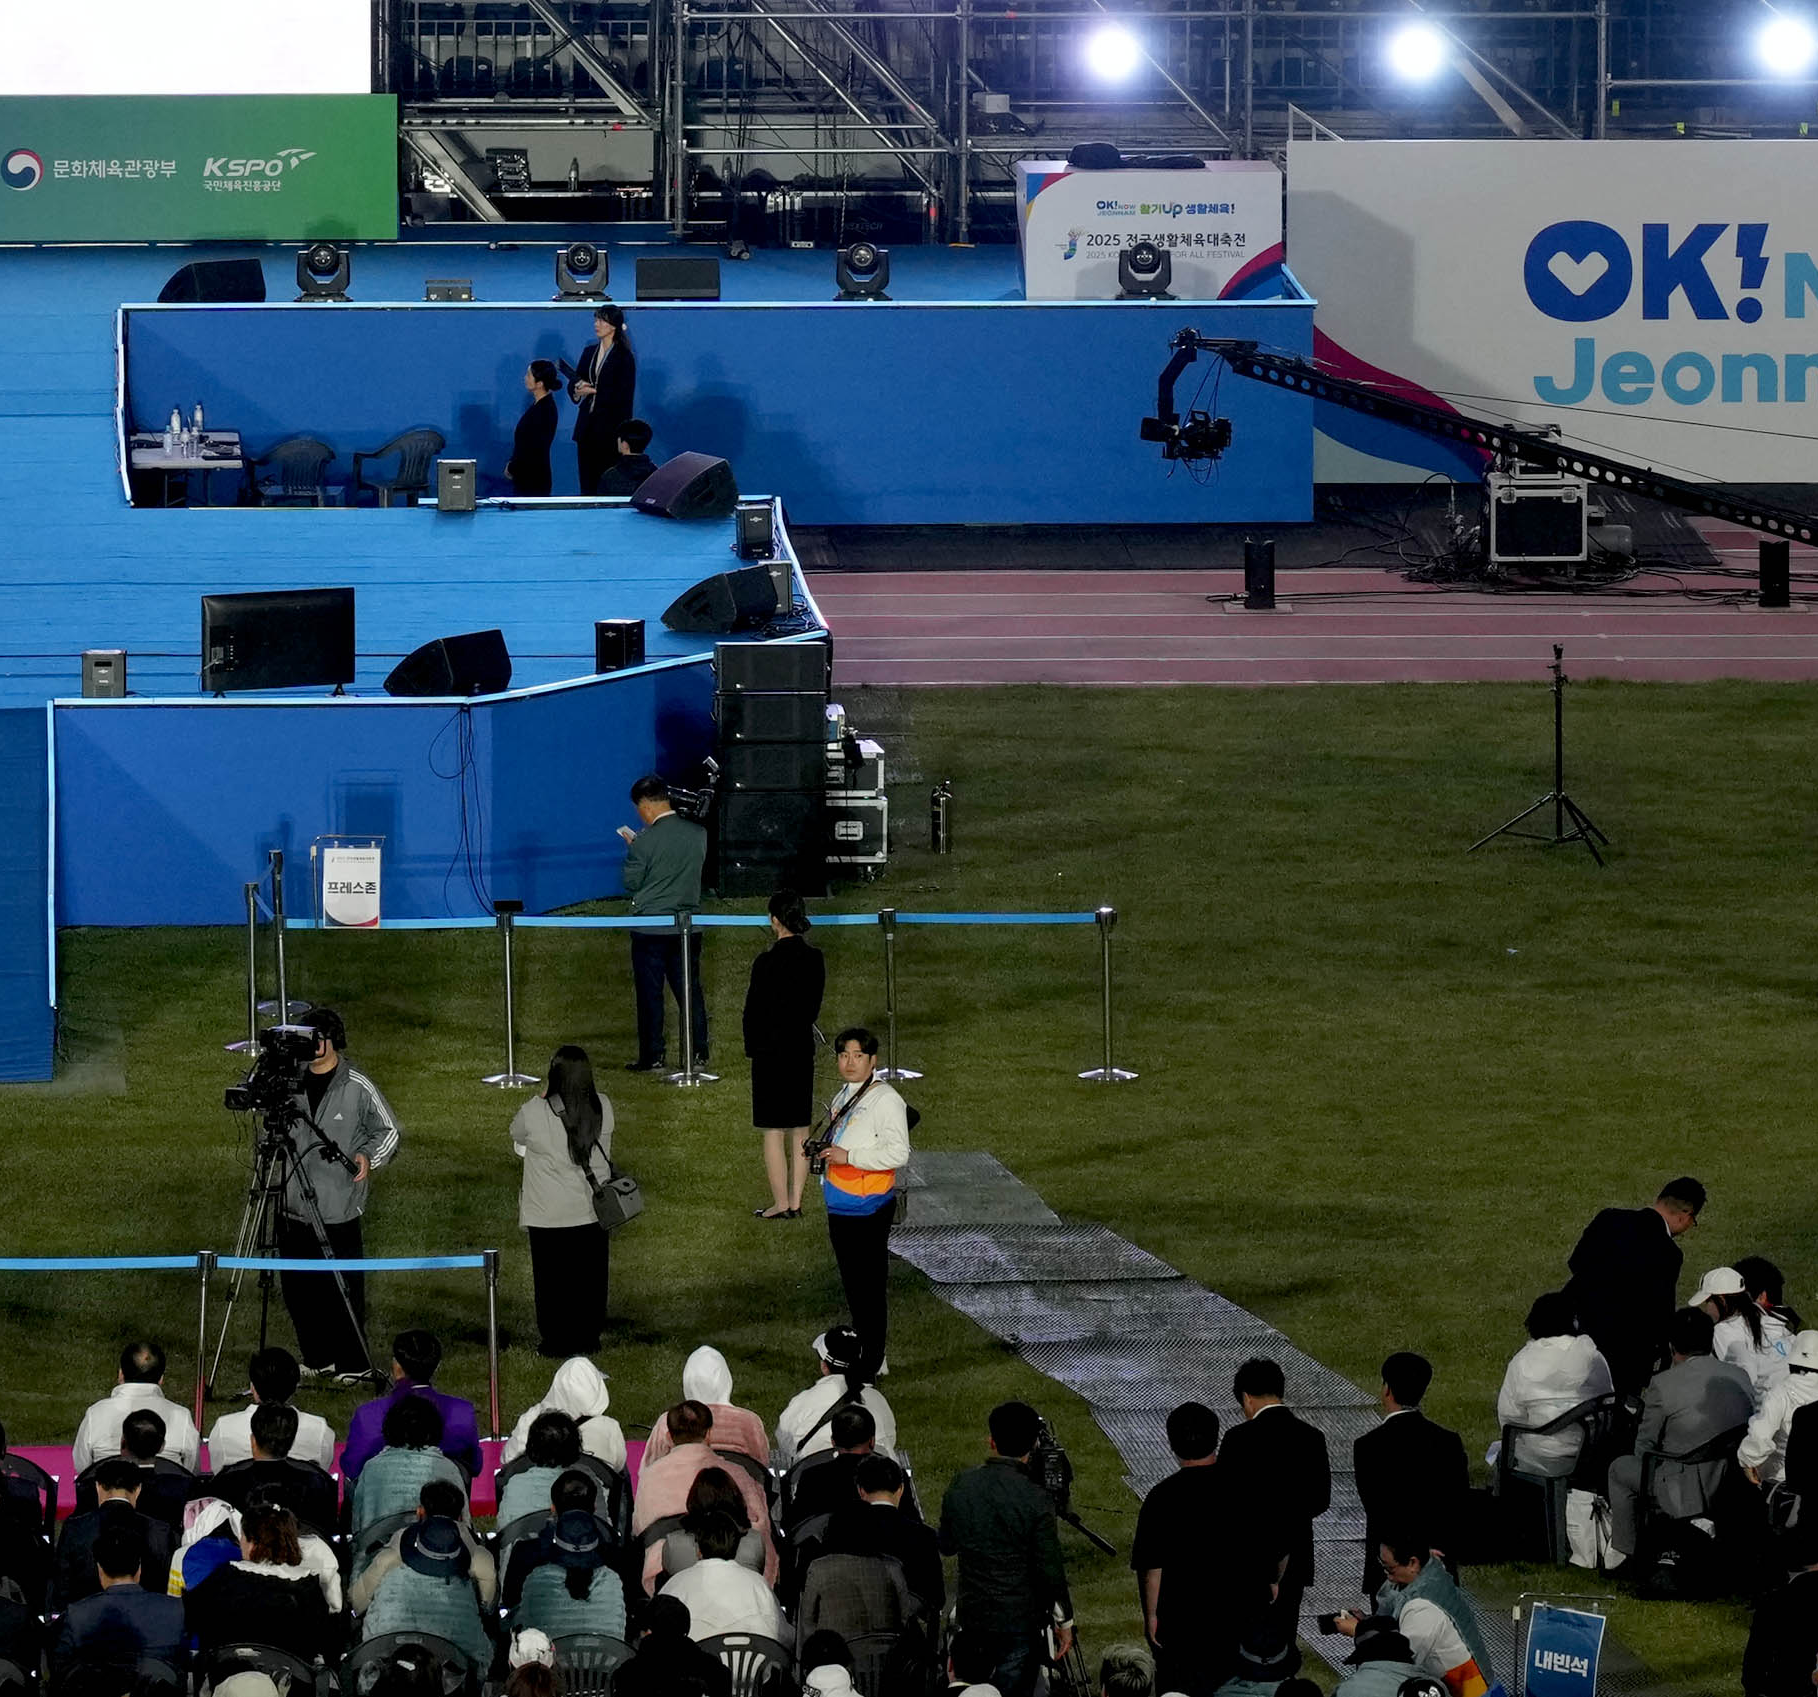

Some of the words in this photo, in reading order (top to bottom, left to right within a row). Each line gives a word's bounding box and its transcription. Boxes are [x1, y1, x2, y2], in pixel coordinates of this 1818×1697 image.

[53, 159, 178, 179] 문화체육관광부
[203, 157, 284, 177] KSPO
[1096, 200, 1118, 210] OK!
[1086, 234, 1121, 247] 2025
[1524, 220, 1769, 324] OK!
[327, 881, 376, 894] 프레스존
[1534, 1649, 1590, 1678] 내빈석
